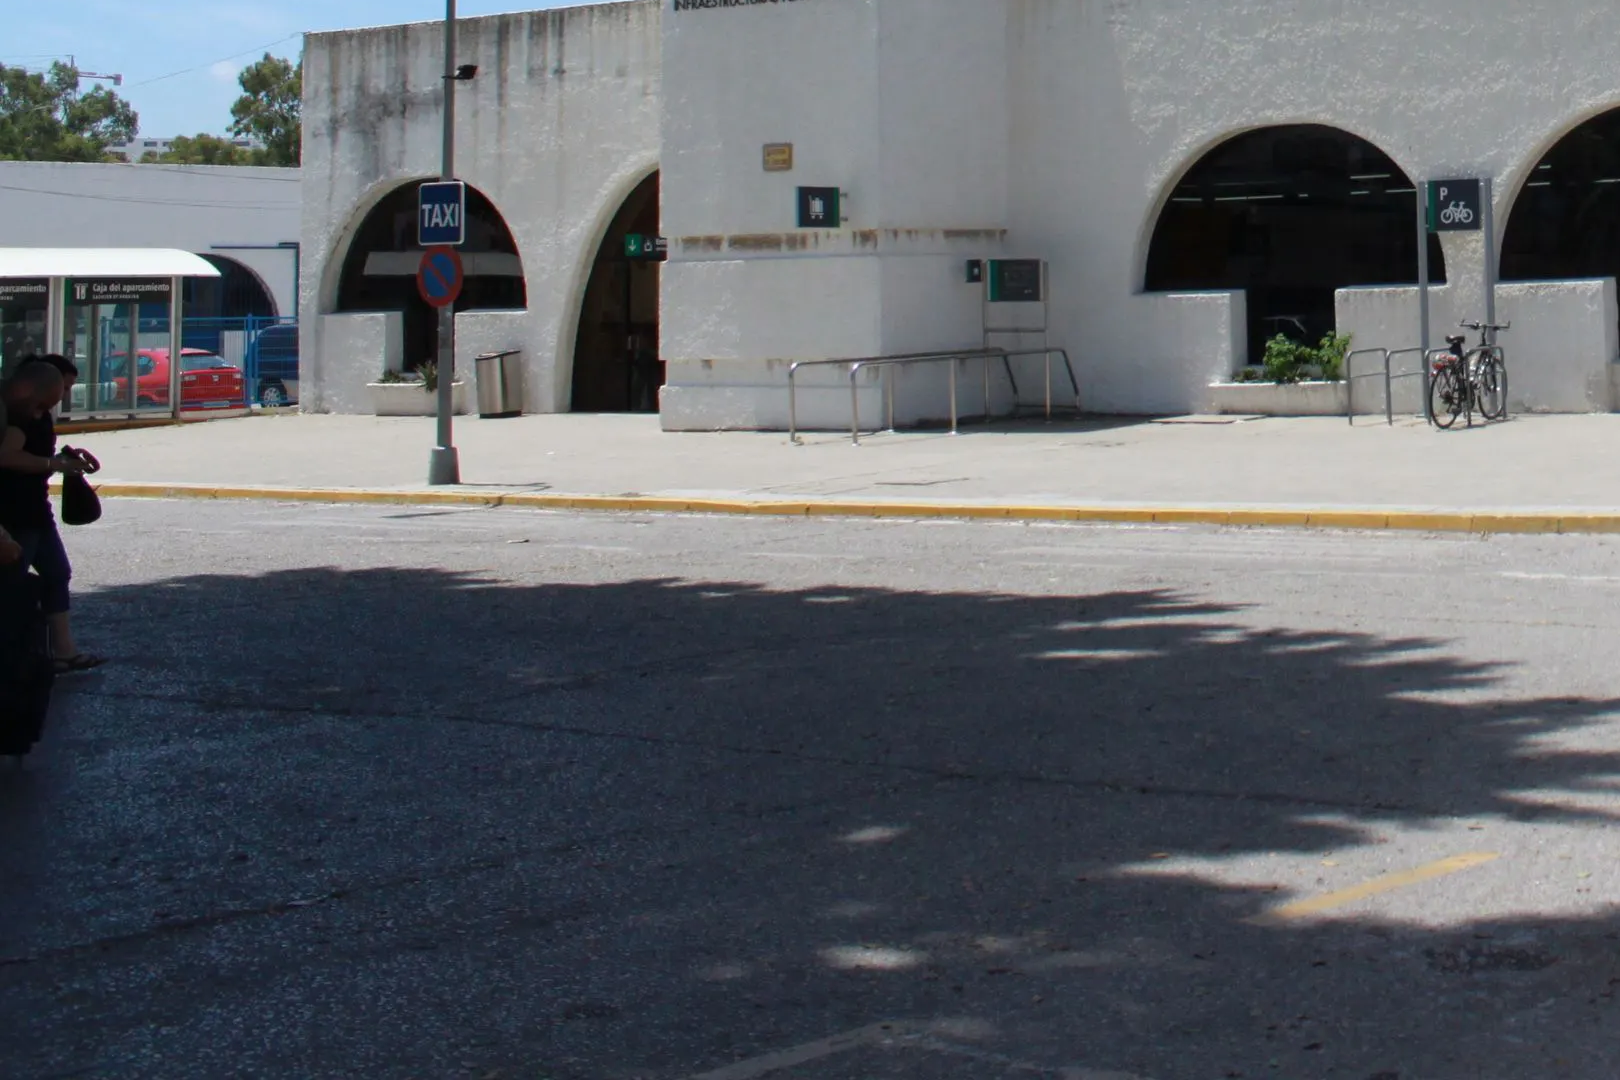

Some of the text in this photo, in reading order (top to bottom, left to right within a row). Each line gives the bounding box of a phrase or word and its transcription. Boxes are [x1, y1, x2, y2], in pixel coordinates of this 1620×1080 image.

[1440, 186, 1448, 201] P
[421, 203, 460, 228] TAXI
[93, 283, 170, 294] Caja del aparcamiento
